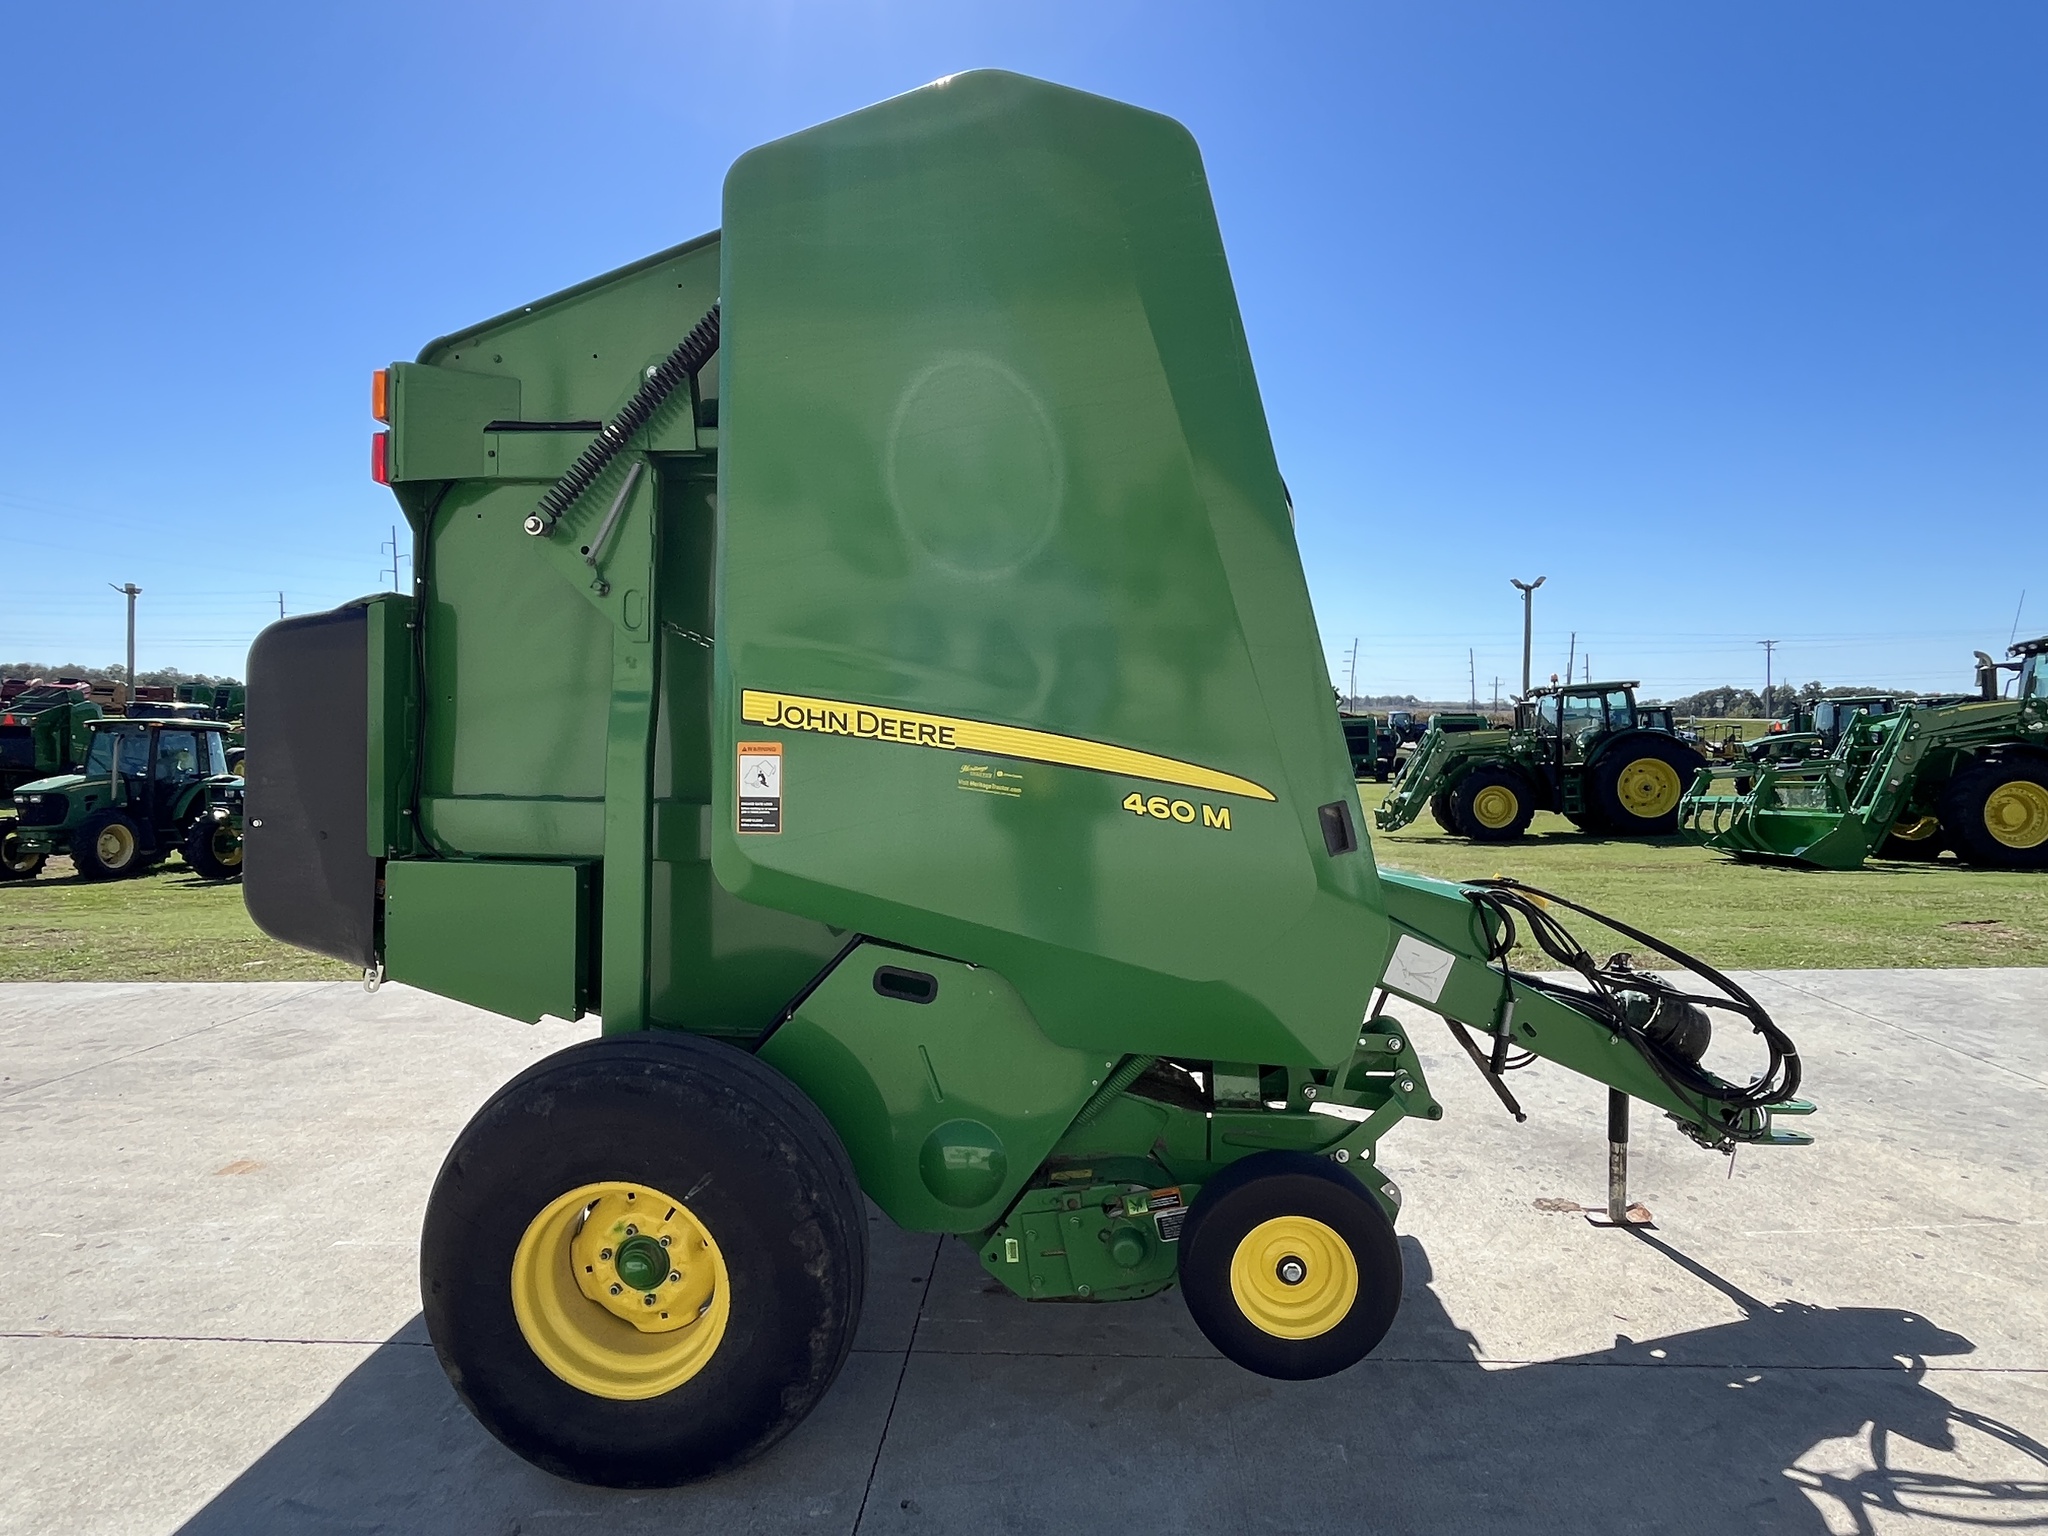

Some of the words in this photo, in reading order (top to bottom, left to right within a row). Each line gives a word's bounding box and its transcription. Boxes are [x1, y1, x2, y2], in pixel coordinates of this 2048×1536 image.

[767, 701, 848, 731] JOHN
[857, 710, 956, 746] DEERE
[1122, 792, 1196, 824] 460
[1202, 804, 1232, 831] M
